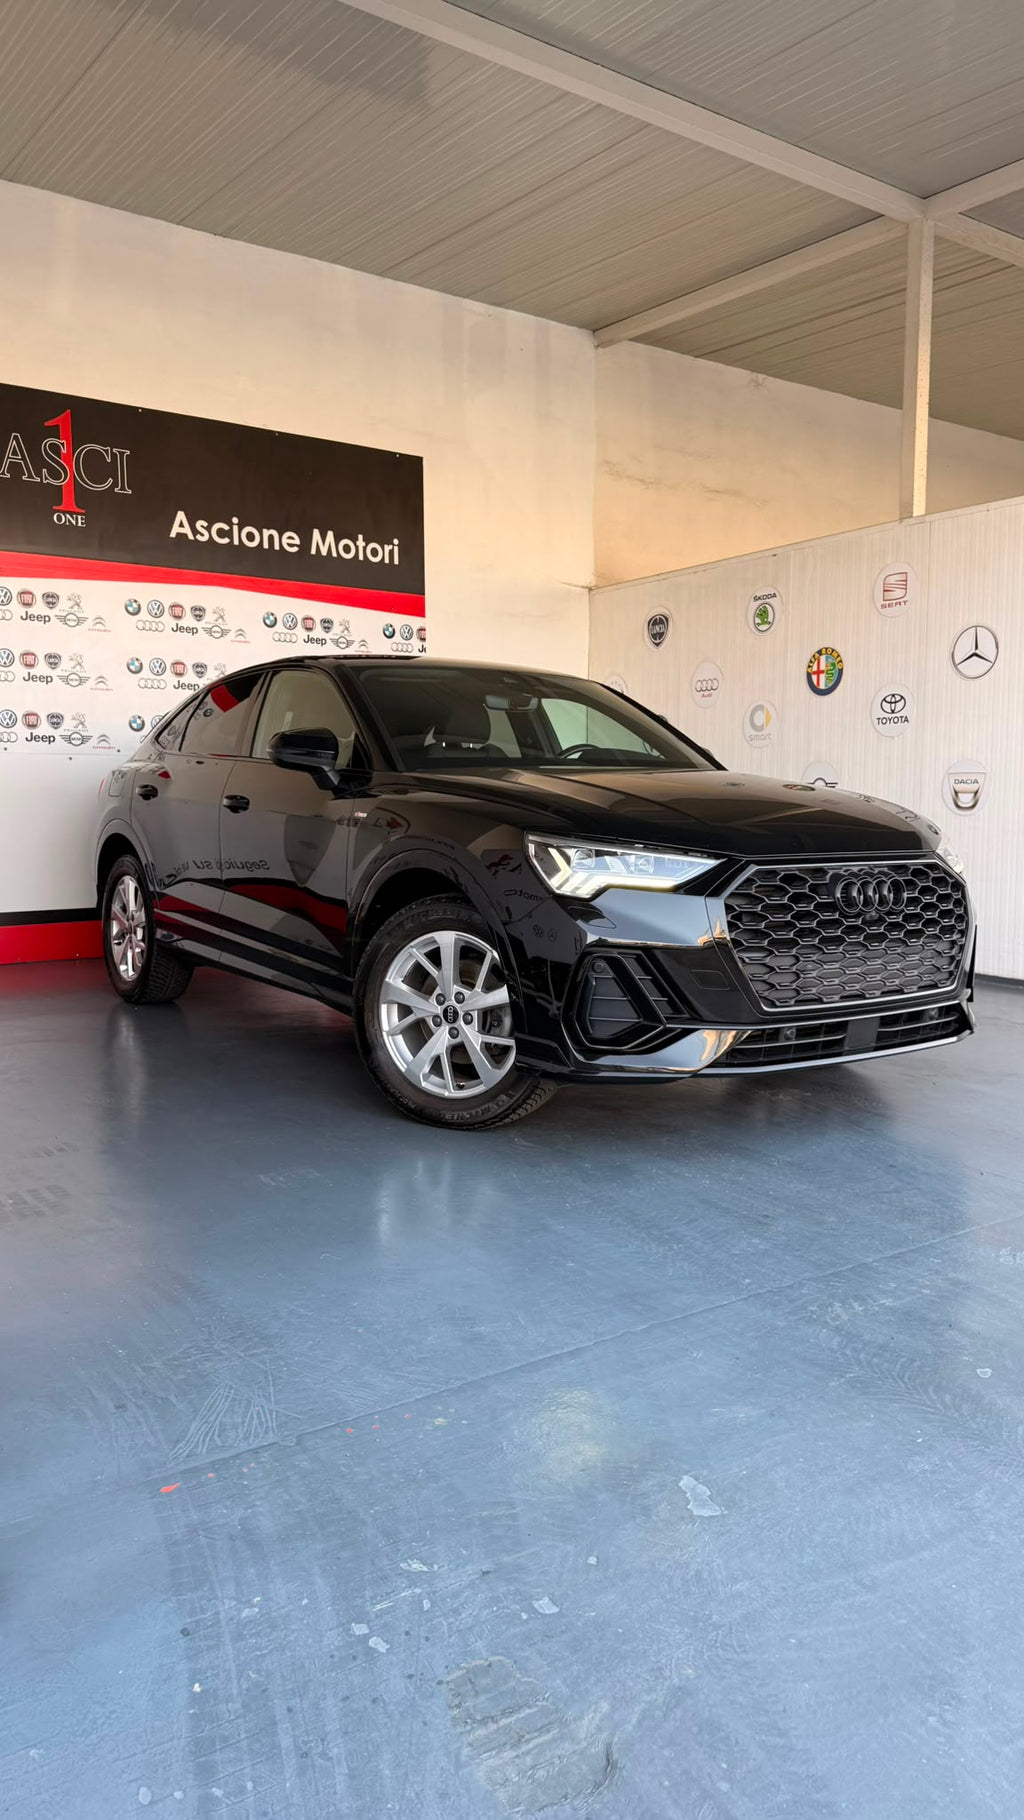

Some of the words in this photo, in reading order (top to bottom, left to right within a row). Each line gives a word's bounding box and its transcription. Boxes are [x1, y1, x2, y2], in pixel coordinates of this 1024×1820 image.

[0, 432, 132, 494] ASCI
[53, 512, 86, 527] ONE
[169, 510, 301, 553] Ascione
[310, 528, 400, 565] Motori
[881, 600, 909, 609] SEAT
[20, 611, 51, 624] Jeep
[171, 623, 199, 636] Jeep
[303, 634, 327, 647] Jeep
[23, 671, 54, 685] Jeep
[173, 680, 200, 692] Jeep
[877, 715, 909, 726] TOYOTA
[25, 731, 56, 745] Jeep
[749, 732, 772, 742] smart
